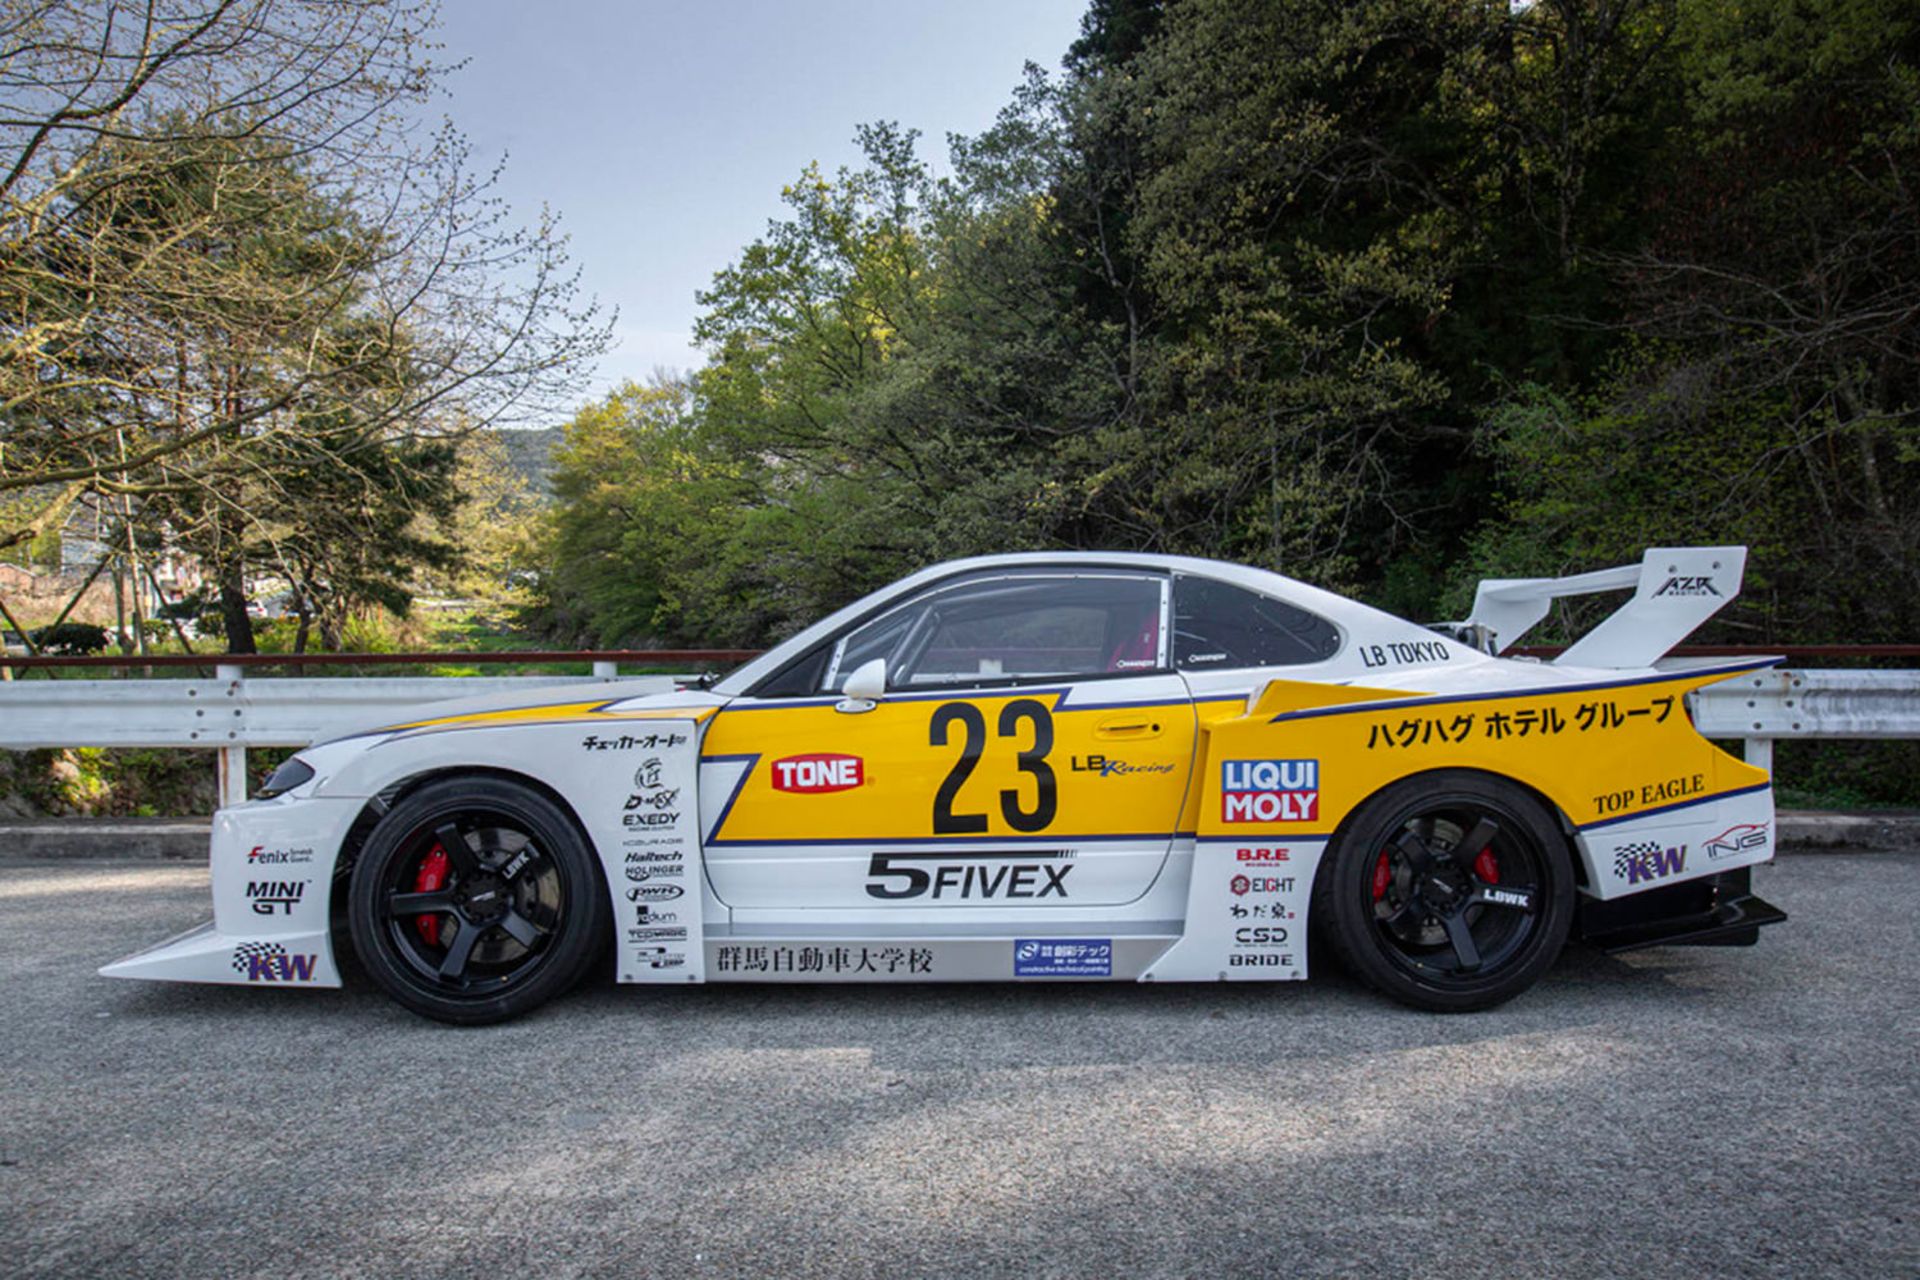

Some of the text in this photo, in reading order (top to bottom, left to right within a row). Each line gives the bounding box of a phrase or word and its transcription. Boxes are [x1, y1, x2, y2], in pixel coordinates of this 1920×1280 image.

[1360, 641, 1450, 668] LB TOKYO
[1367, 695, 1675, 749] ハグハグ ホテル グループ
[778, 759, 858, 788] TONE
[929, 699, 1058, 835] 23
[1071, 755, 1106, 772] LB
[1226, 761, 1316, 790] LIQUI
[1225, 792, 1317, 821] MOLY
[1593, 774, 1705, 815] TOP EAGLE
[622, 812, 681, 826] EXEDY
[624, 850, 683, 863] Haltech
[1236, 848, 1291, 861] B.R.E
[1707, 829, 1768, 859] ING
[1625, 844, 1688, 886] KW
[246, 881, 305, 898] MINI
[1252, 877, 1296, 893] EIGHT
[1483, 889, 1529, 907] LBWK
[251, 897, 301, 915] GT
[1235, 927, 1288, 943] CSD
[247, 953, 318, 982] KW
[717, 946, 933, 974] 群馬自動車大学校
[1229, 954, 1293, 967] BRIDE
